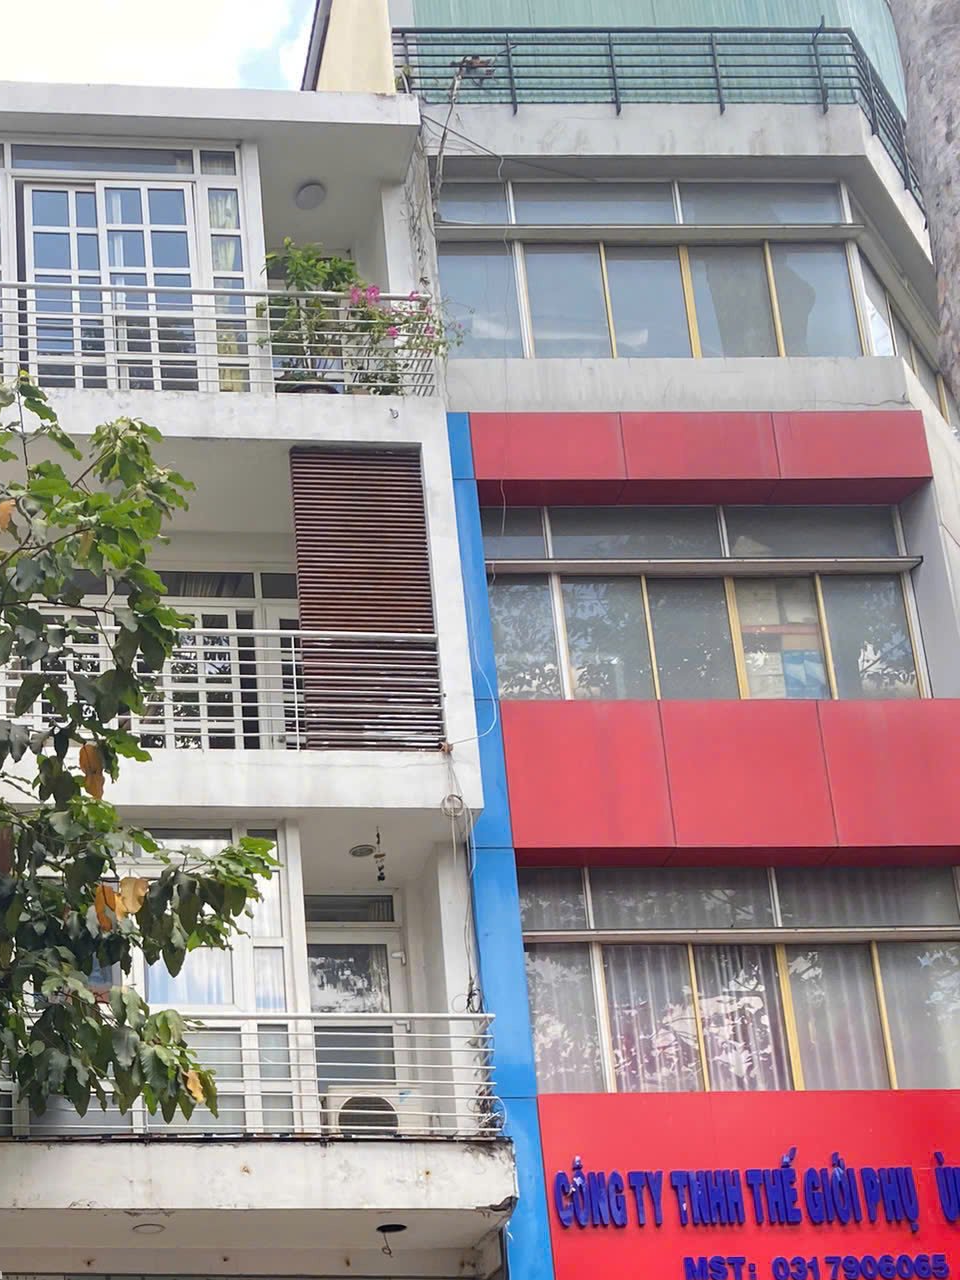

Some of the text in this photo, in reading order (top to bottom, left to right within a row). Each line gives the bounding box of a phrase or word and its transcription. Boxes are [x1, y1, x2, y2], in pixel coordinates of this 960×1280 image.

[628, 1170, 663, 1227] TY
[670, 1170, 746, 1227] TNHH
[745, 1147, 802, 1225] THẾ
[861, 1167, 920, 1233] PHỤ
